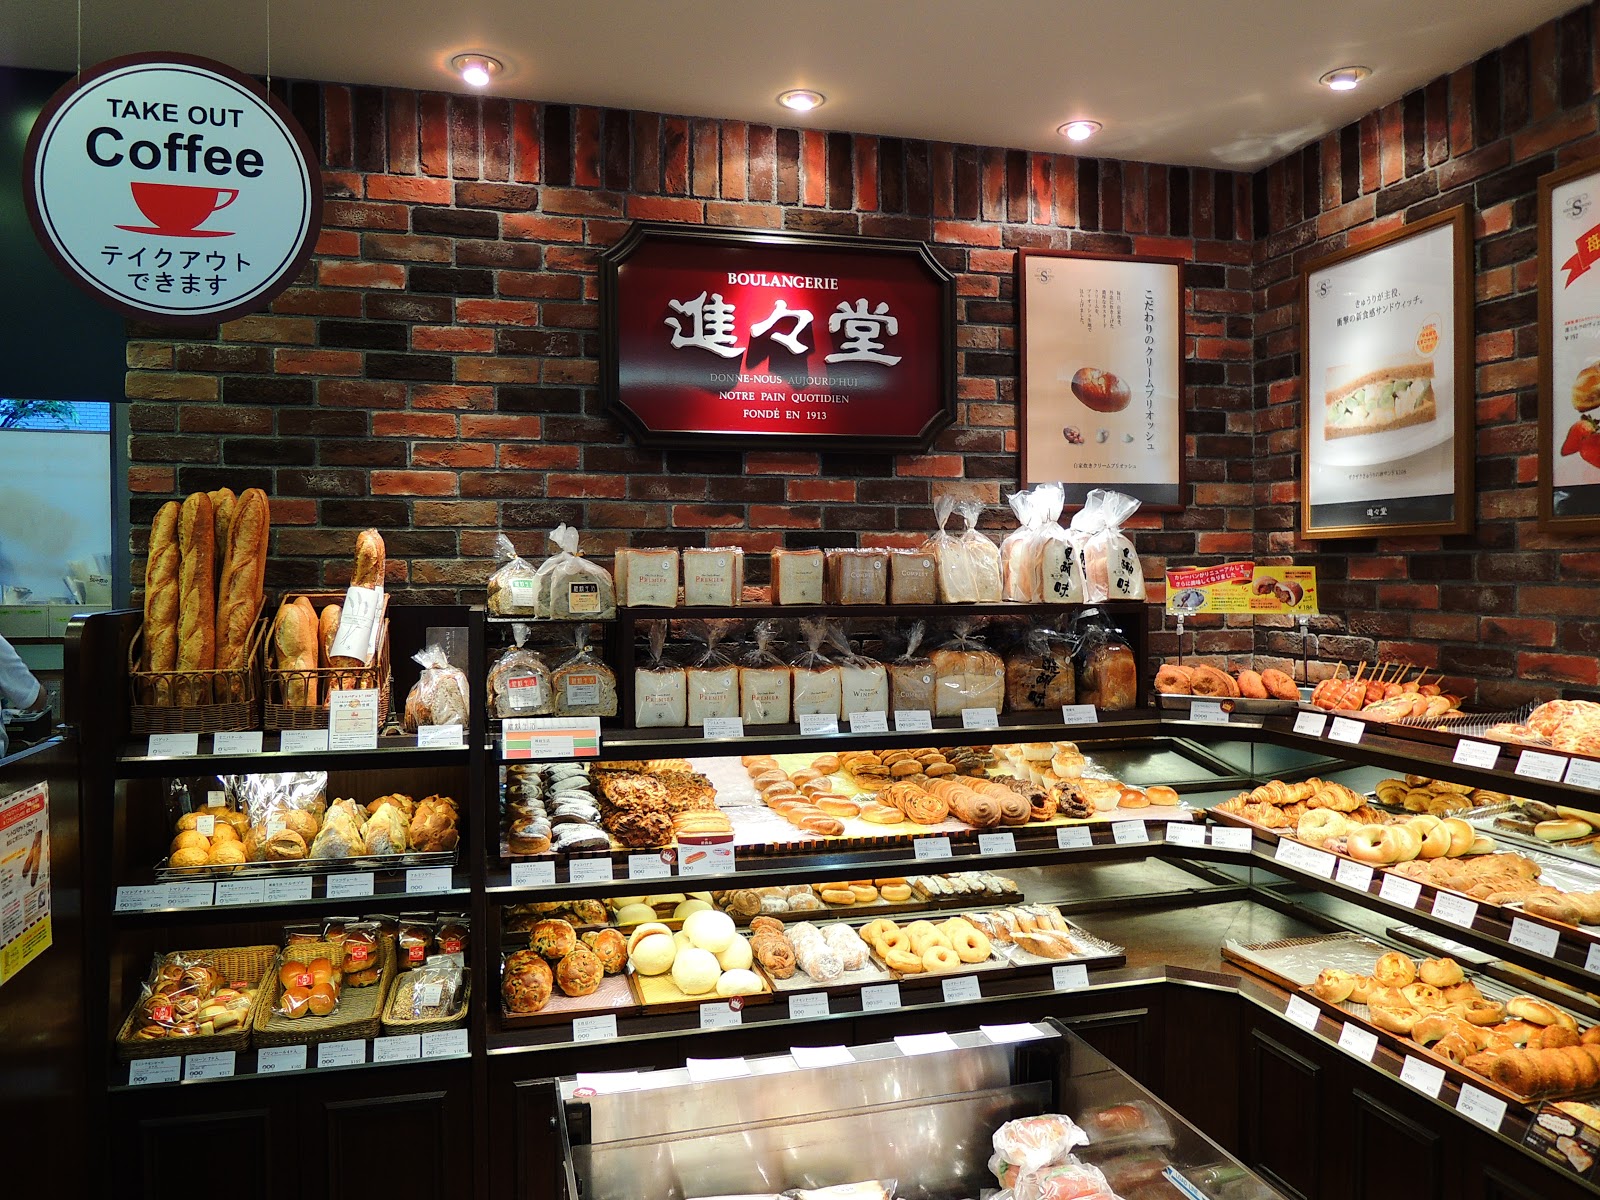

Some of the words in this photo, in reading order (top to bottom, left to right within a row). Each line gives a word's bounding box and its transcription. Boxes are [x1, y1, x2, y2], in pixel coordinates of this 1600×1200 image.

[107, 98, 178, 122] TAKE
[188, 106, 243, 127] OUT
[86, 127, 264, 178] Coffee
[1572, 199, 1582, 216] S
[101, 246, 250, 272] テイクアウト
[128, 272, 227, 296] できます
[728, 272, 838, 290] BOULANGERIE
[1040, 270, 1048, 282] S
[1320, 284, 1328, 296] S
[1356, 288, 1401, 309] きゅうりが主役、
[1336, 294, 1422, 327] 衝撃の新食感サンドウィッチ。
[664, 290, 902, 366] 進々堂
[1144, 290, 1155, 450] こだわりのクリームブリオッシュ
[710, 373, 782, 384] DONNE-NOUS
[788, 376, 858, 388] AUJOURD'HUI
[718, 390, 755, 401] NOTRE
[760, 392, 786, 402] PAIN
[791, 393, 850, 404] QUOTIDIEN
[742, 408, 780, 419] FONDÉ
[786, 411, 800, 420] EN
[806, 411, 827, 420] 1913
[1366, 506, 1388, 516] 進々堂
[1174, 564, 1244, 580] カレーパンがリニューアルして
[1176, 572, 1236, 588] さらに美味しくなりました
